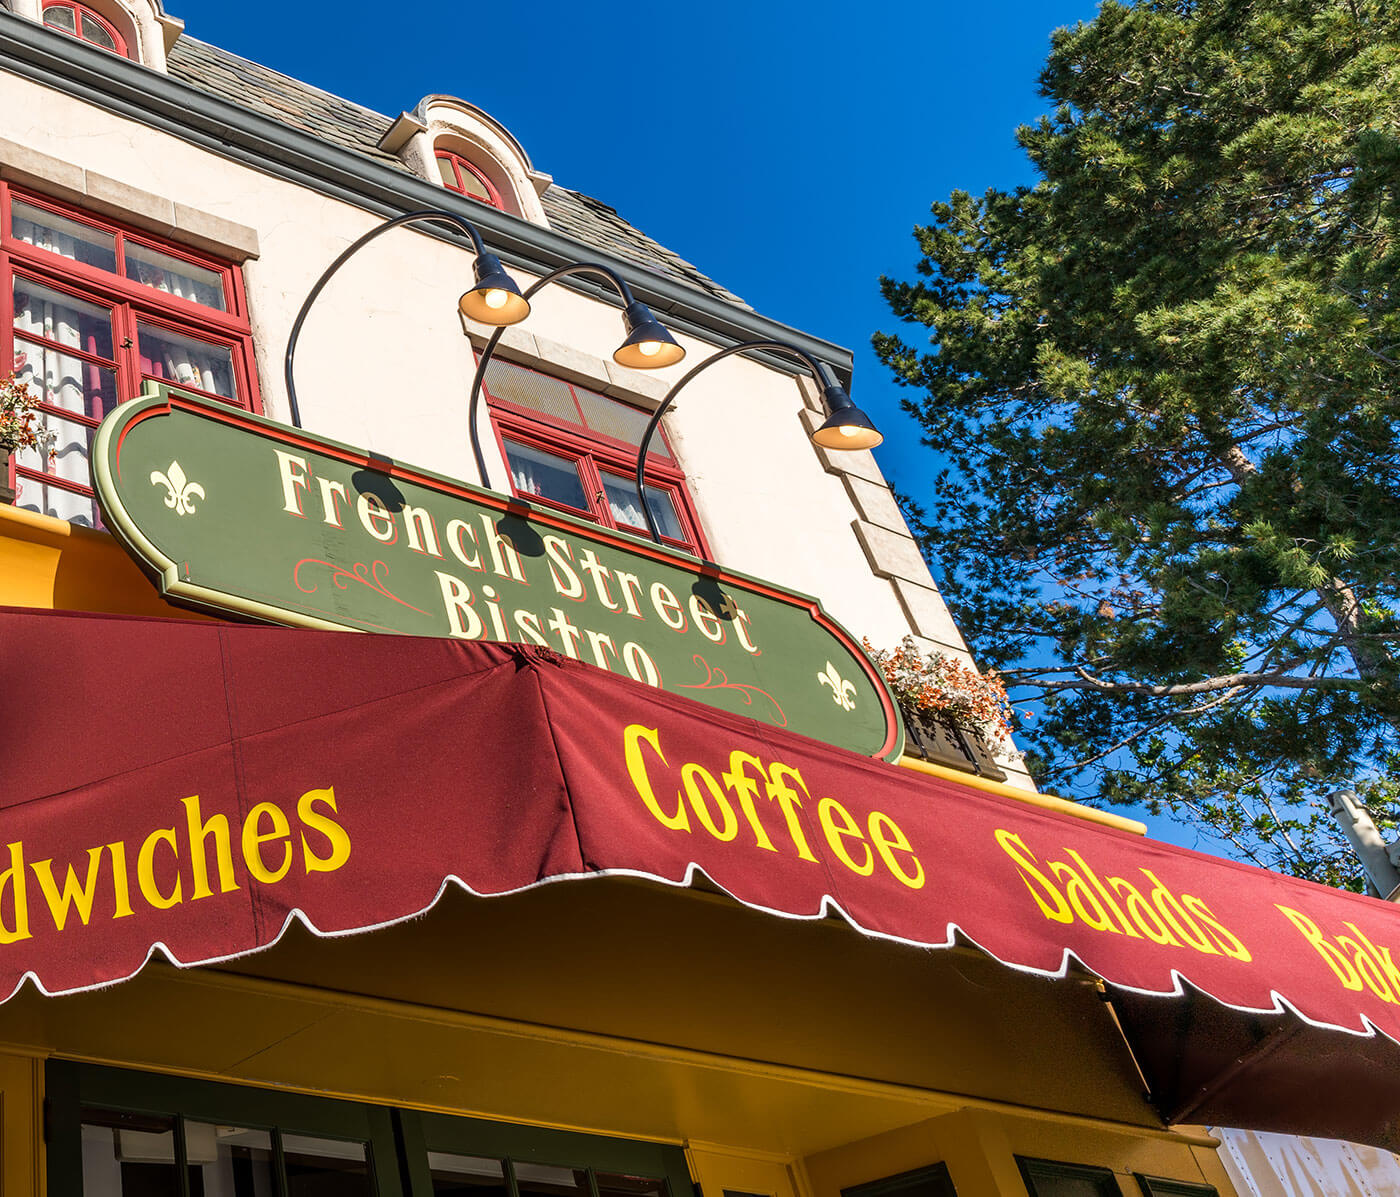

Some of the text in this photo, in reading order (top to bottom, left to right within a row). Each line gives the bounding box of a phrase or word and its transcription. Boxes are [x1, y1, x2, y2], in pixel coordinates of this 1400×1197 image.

[272, 449, 760, 654] French Street
[433, 570, 660, 688] Bistro
[624, 724, 926, 889] Coffee
[994, 828, 1252, 962] Salads
